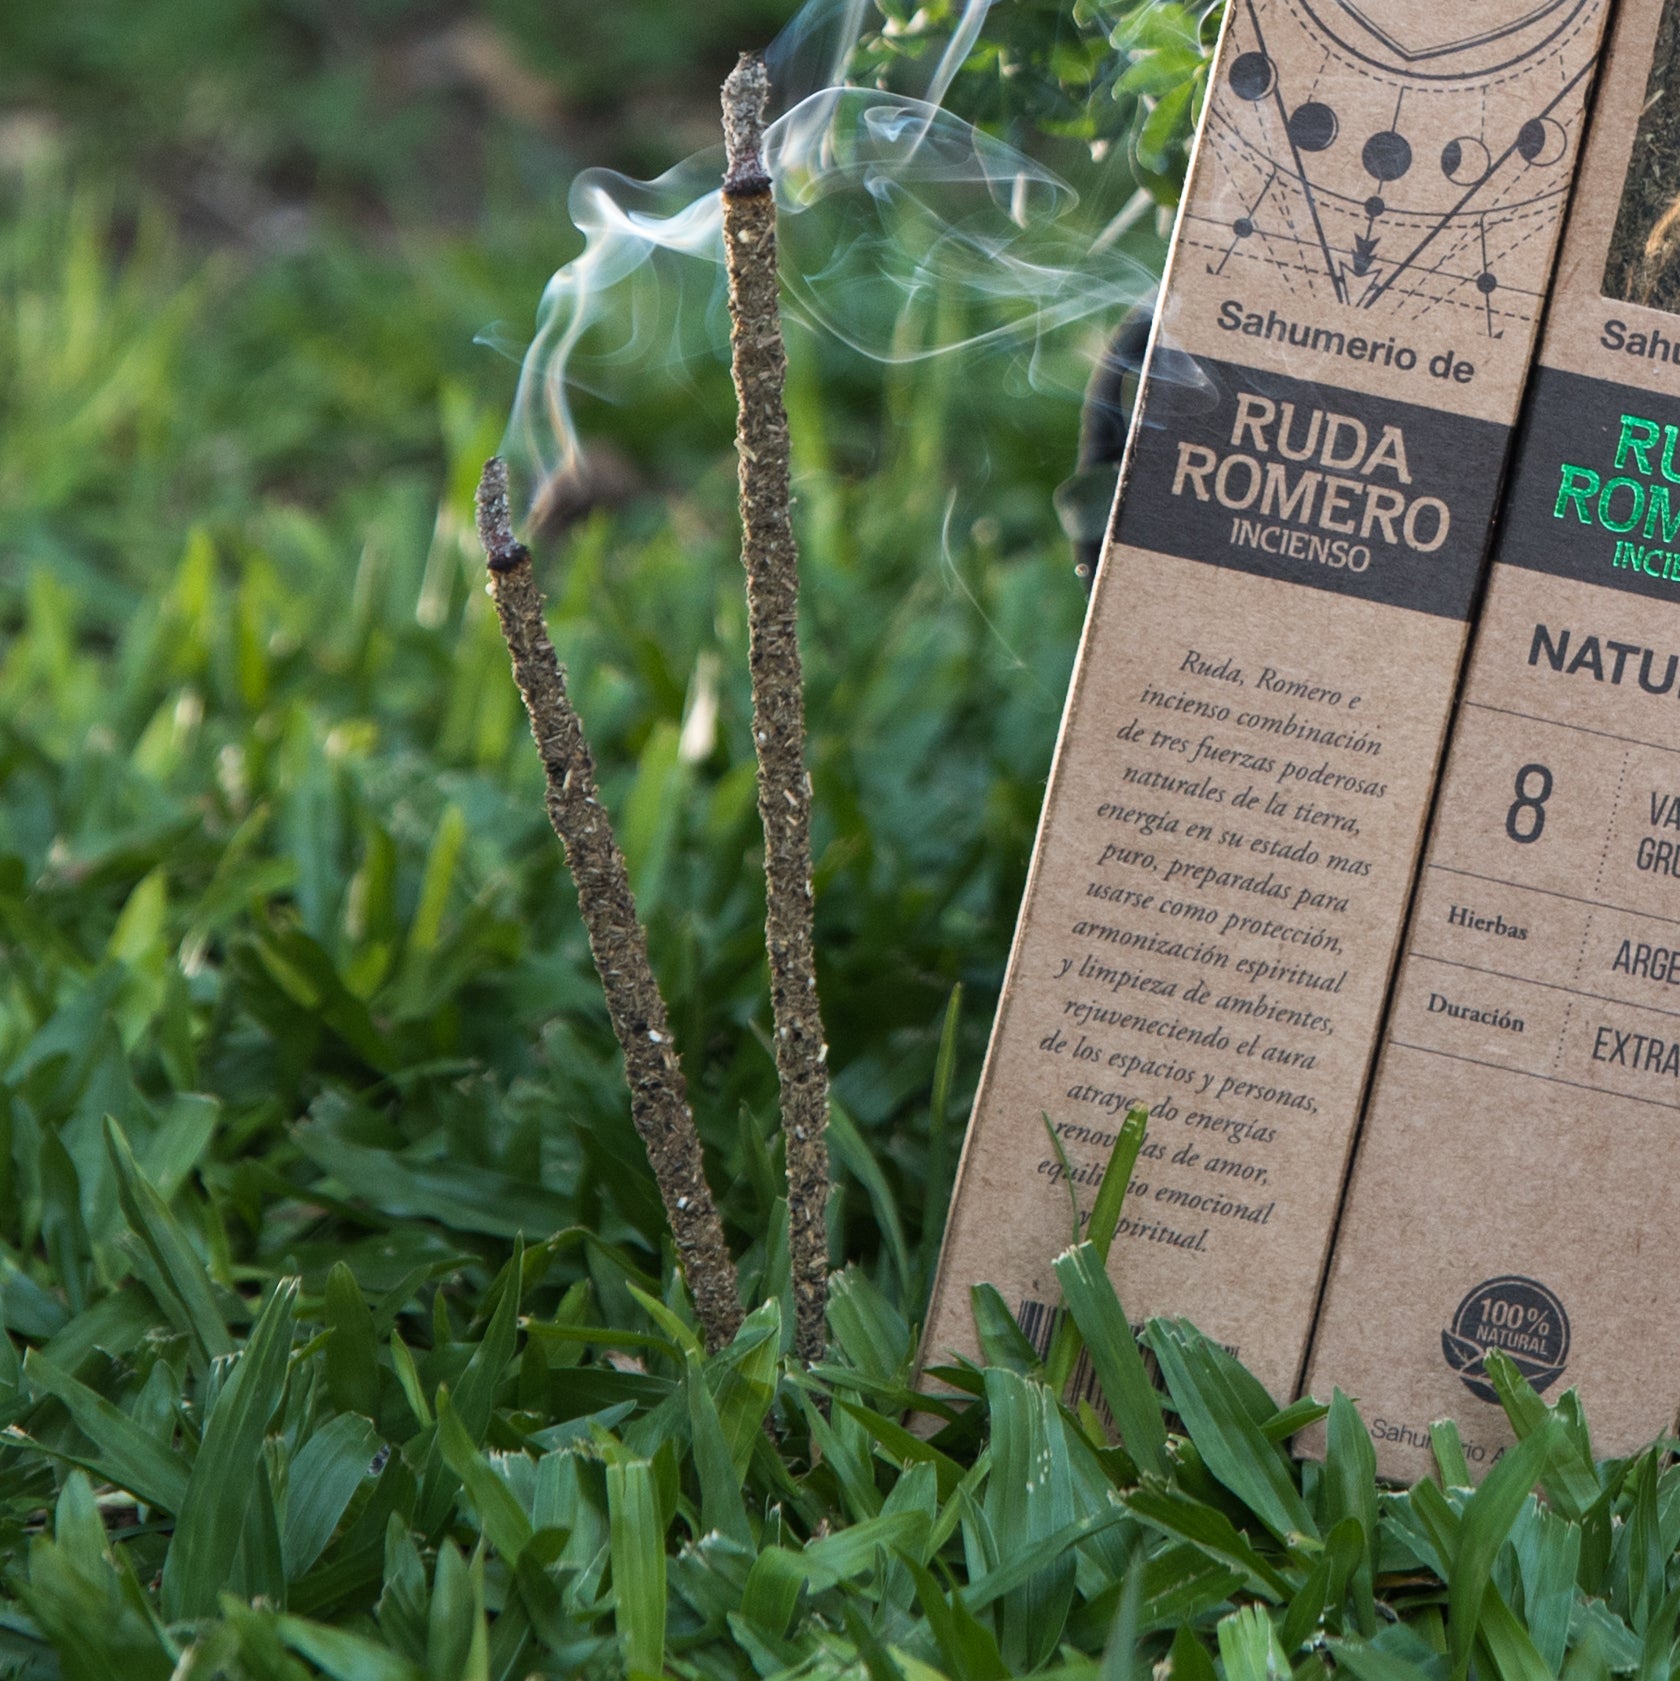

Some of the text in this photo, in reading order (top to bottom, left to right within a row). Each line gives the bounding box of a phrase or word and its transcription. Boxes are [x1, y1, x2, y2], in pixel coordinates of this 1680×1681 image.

[1217, 300, 1475, 385] Sahumerio de
[1230, 391, 1412, 485] RUDA
[1171, 441, 1451, 552] ROMERO
[1230, 518, 1371, 573] INCIENSO
[1179, 650, 1361, 710] Ruda, Romero e
[1140, 684, 1382, 756] incienso combinación
[1117, 720, 1388, 798] de tres fuerzas poderosas
[1123, 767, 1361, 835] naturales de la tierra,
[1505, 763, 1554, 844] 8
[1097, 801, 1372, 878] energía en su estado mas
[1097, 843, 1349, 914] puro, preparadas para
[1087, 880, 1344, 956] usarse como protección,
[1448, 905, 1528, 941] Hierbas
[1072, 918, 1347, 994] armonización espiritual
[1054, 956, 1334, 1036] y limpieza de ambientes,
[1428, 993, 1525, 1033] Duración
[1063, 997, 1316, 1071] rejuveneciendo el aura
[1592, 1027, 1680, 1077] EXTRA
[1039, 1029, 1318, 1113] de los espacios y personas,
[1067, 1084, 1277, 1143] atrayedo energías
[1171, 1143, 1199, 1167] de
[1204, 1157, 1268, 1185] amor,
[1155, 1185, 1275, 1225] emocional
[1476, 1324, 1548, 1355] NATURAL
[1480, 1298, 1550, 1336] 100%
